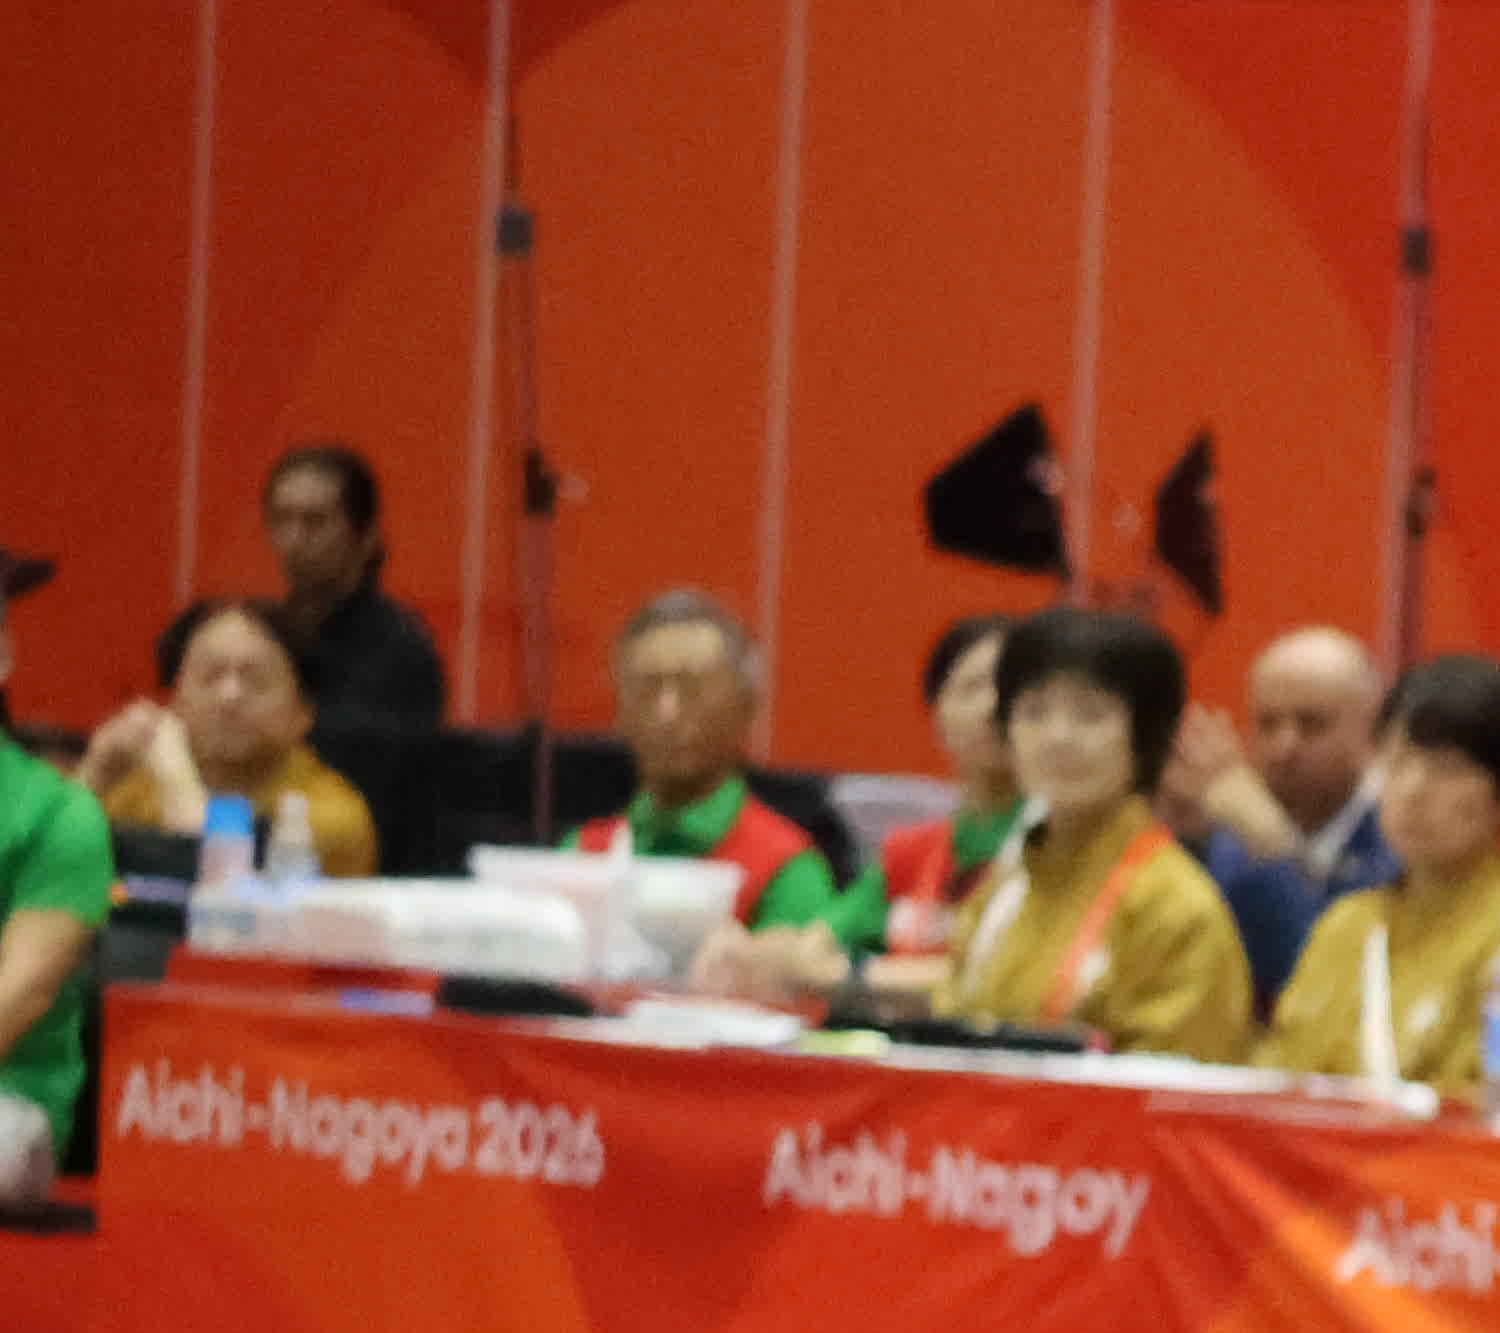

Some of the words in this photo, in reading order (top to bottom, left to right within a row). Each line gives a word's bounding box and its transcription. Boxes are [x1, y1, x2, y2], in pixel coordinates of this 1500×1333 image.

[118, 1061, 467, 1189] Aichi-Nagoya
[474, 1099, 605, 1187] 2026
[765, 1122, 1149, 1260] Aichi-Nagoy
